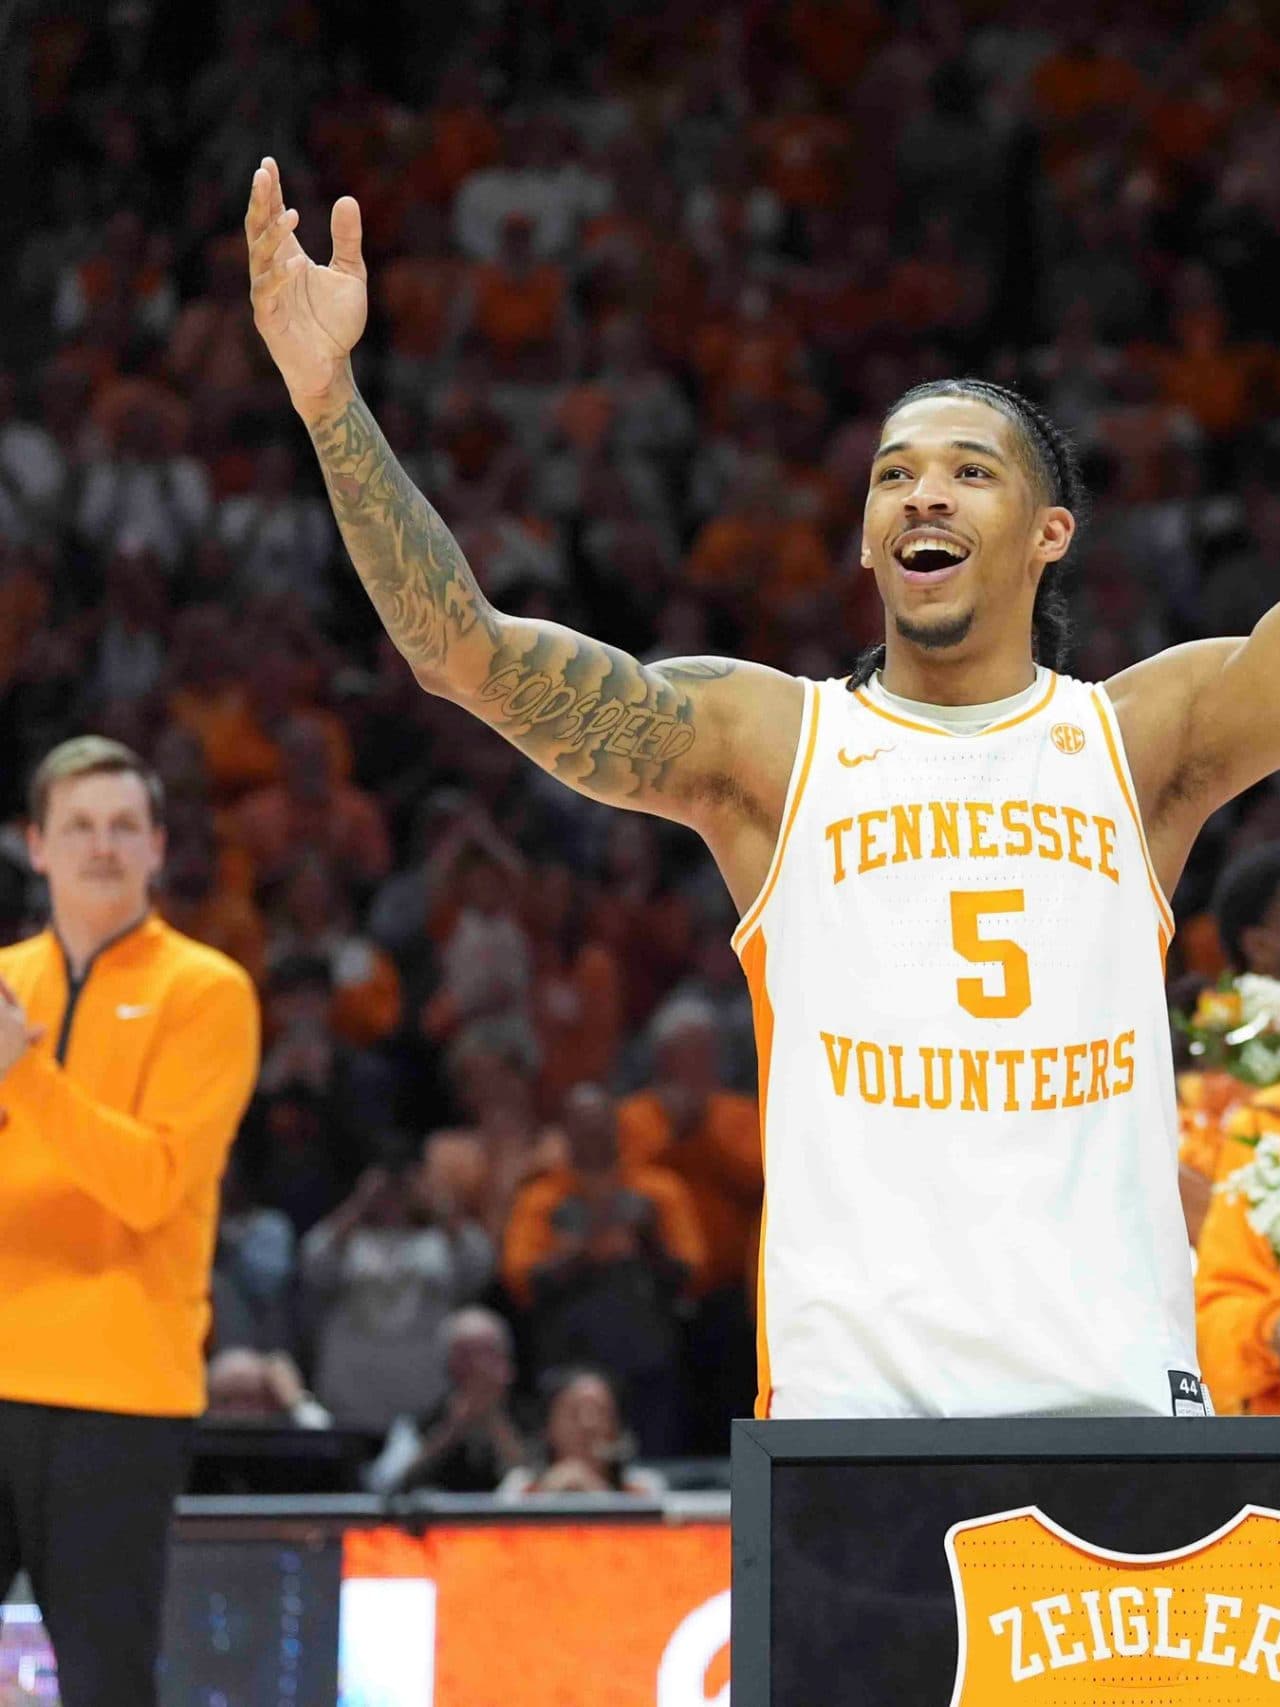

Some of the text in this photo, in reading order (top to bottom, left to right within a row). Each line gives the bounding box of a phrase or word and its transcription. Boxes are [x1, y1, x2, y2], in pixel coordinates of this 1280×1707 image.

[477, 661, 697, 765] GODSPEED
[1053, 725, 1083, 751] SEC
[825, 800, 1120, 884] TENNESSEE
[949, 888, 1032, 1020] 5
[819, 1030, 1136, 1112] VOLUNTEERS
[1179, 1377, 1198, 1396] 44
